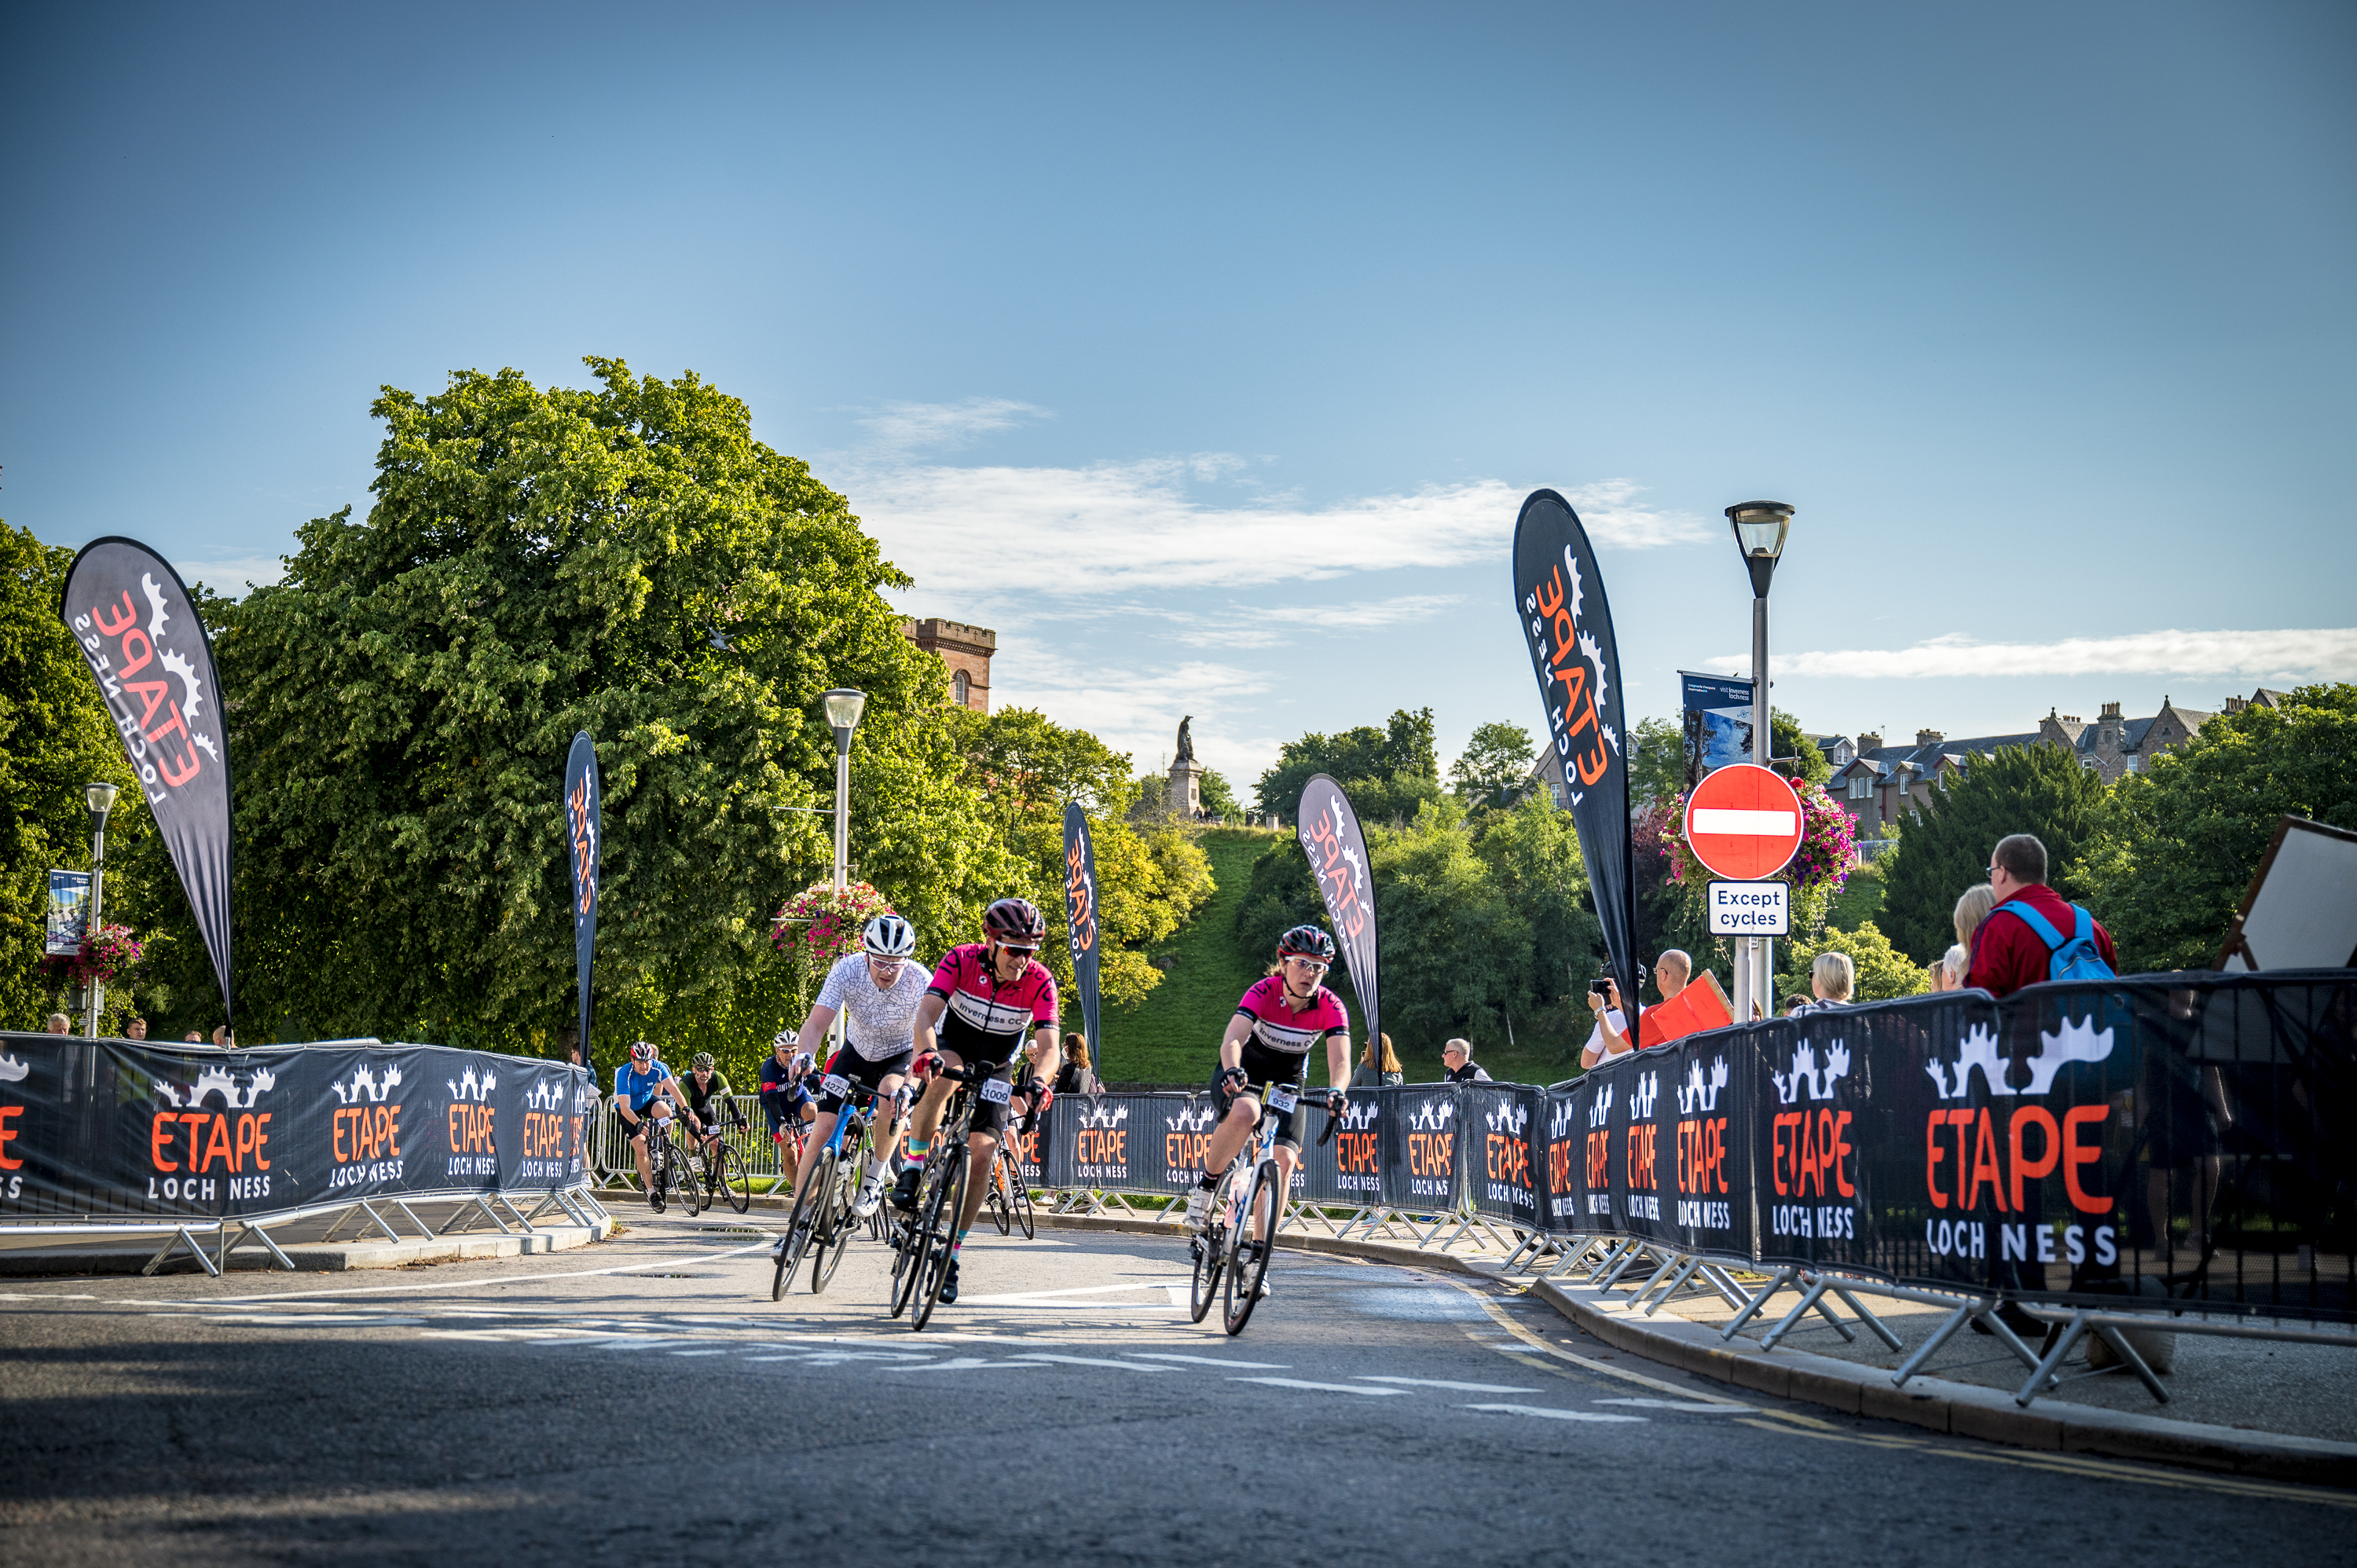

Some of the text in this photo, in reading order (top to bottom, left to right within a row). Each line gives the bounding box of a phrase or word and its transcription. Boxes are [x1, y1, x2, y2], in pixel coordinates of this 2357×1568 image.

[1717, 890, 1780, 908] Except
[1721, 910, 1776, 929] cycles
[1259, 1028, 1301, 1047] Inverness
[824, 1081, 845, 1095] 4277
[985, 1089, 1008, 1101] 1009
[1273, 1098, 1289, 1109] 932
[151, 1112, 272, 1173] ETAPE
[333, 1105, 401, 1163] ETAPE
[449, 1104, 496, 1155] ETAPE
[523, 1112, 563, 1158] ETAPE
[1078, 1130, 1127, 1163] ETAPE
[1166, 1133, 1213, 1168] ETAPE
[1337, 1133, 1378, 1173] ETAPE
[1409, 1134, 1453, 1177] ETAPE
[1486, 1133, 1532, 1188] ETAPE
[1587, 1130, 1609, 1189] ETAPE
[1628, 1123, 1656, 1190] ETAPE
[1677, 1117, 1728, 1194] ETAPE
[1772, 1111, 1854, 1198] ETAPE
[1926, 1105, 2113, 1214] ETAPE
[329, 1160, 404, 1188] LOCH NESS
[448, 1156, 495, 1176] LOCH NESS
[522, 1161, 543, 1177] LOCH
[545, 1161, 563, 1178] NESS
[1078, 1165, 1127, 1178] LOCH NESS
[1166, 1169, 1204, 1185] LOCH NE
[1549, 1140, 1571, 1194] ETAPE
[148, 1175, 270, 1200] LOCH NESS
[1291, 1174, 1304, 1188] ESS
[1337, 1175, 1380, 1191] LOCH NESS
[1411, 1179, 1433, 1196] LOCH
[1488, 1183, 1534, 1210] LOCH NESS
[1588, 1194, 1611, 1214] LOCH NESS
[1628, 1195, 1659, 1221] LOCH NESS
[1678, 1200, 1730, 1229] LOCH NESS
[1772, 1205, 1854, 1240] LOCH NESS
[1926, 1218, 2117, 1266] LOCH NESS
